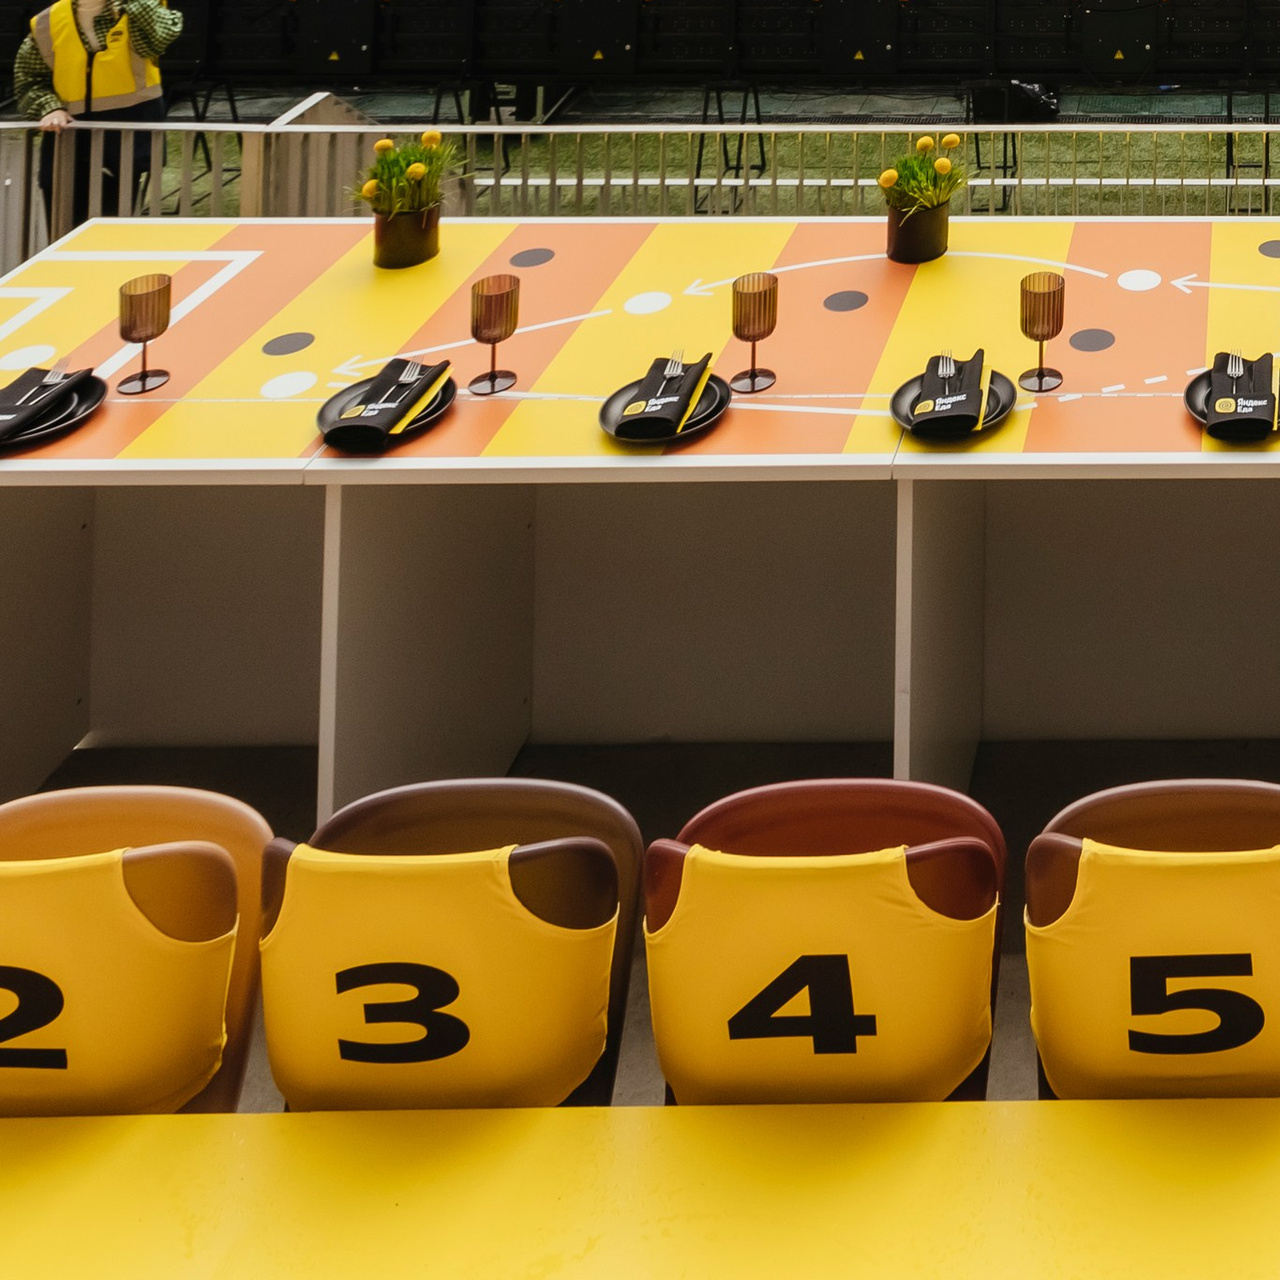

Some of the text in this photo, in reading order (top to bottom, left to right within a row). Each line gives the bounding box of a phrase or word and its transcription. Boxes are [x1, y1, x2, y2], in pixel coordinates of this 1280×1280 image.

[647, 396, 680, 405] Яндекс
[936, 394, 966, 405] Яндекс
[1237, 398, 1267, 407] Яндекс
[935, 403, 951, 411] Еда
[727, 953, 877, 1055] 4
[1127, 952, 1266, 1056] 5
[335, 961, 471, 1065] 3
